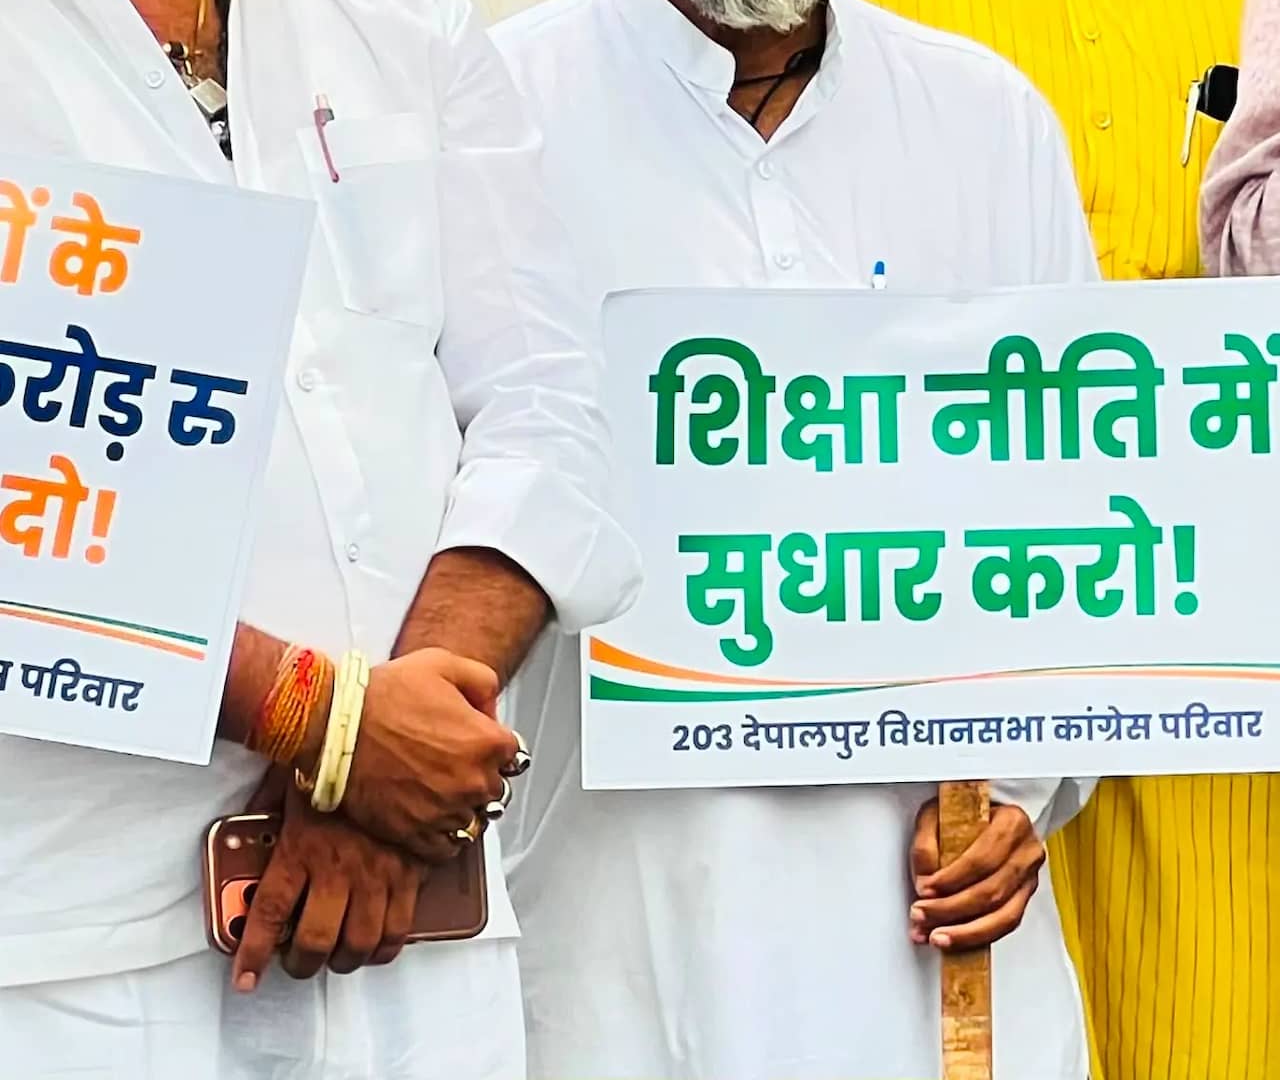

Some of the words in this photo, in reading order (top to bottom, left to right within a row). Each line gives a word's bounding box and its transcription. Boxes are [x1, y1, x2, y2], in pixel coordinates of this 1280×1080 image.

[49, 191, 141, 297] के
[167, 367, 249, 447] रु
[648, 336, 907, 473] शिक्षा
[923, 331, 1166, 462] नीति
[0, 454, 117, 565] दो!
[677, 528, 947, 668] सुधार
[963, 494, 1200, 619] करो!
[20, 657, 145, 712] परिवार
[672, 723, 733, 752] 203
[740, 713, 871, 760] देपालपुर
[876, 709, 1046, 748] विधानसभा
[1051, 704, 1153, 742] कांग्रेस
[1158, 702, 1263, 740] परिवार
